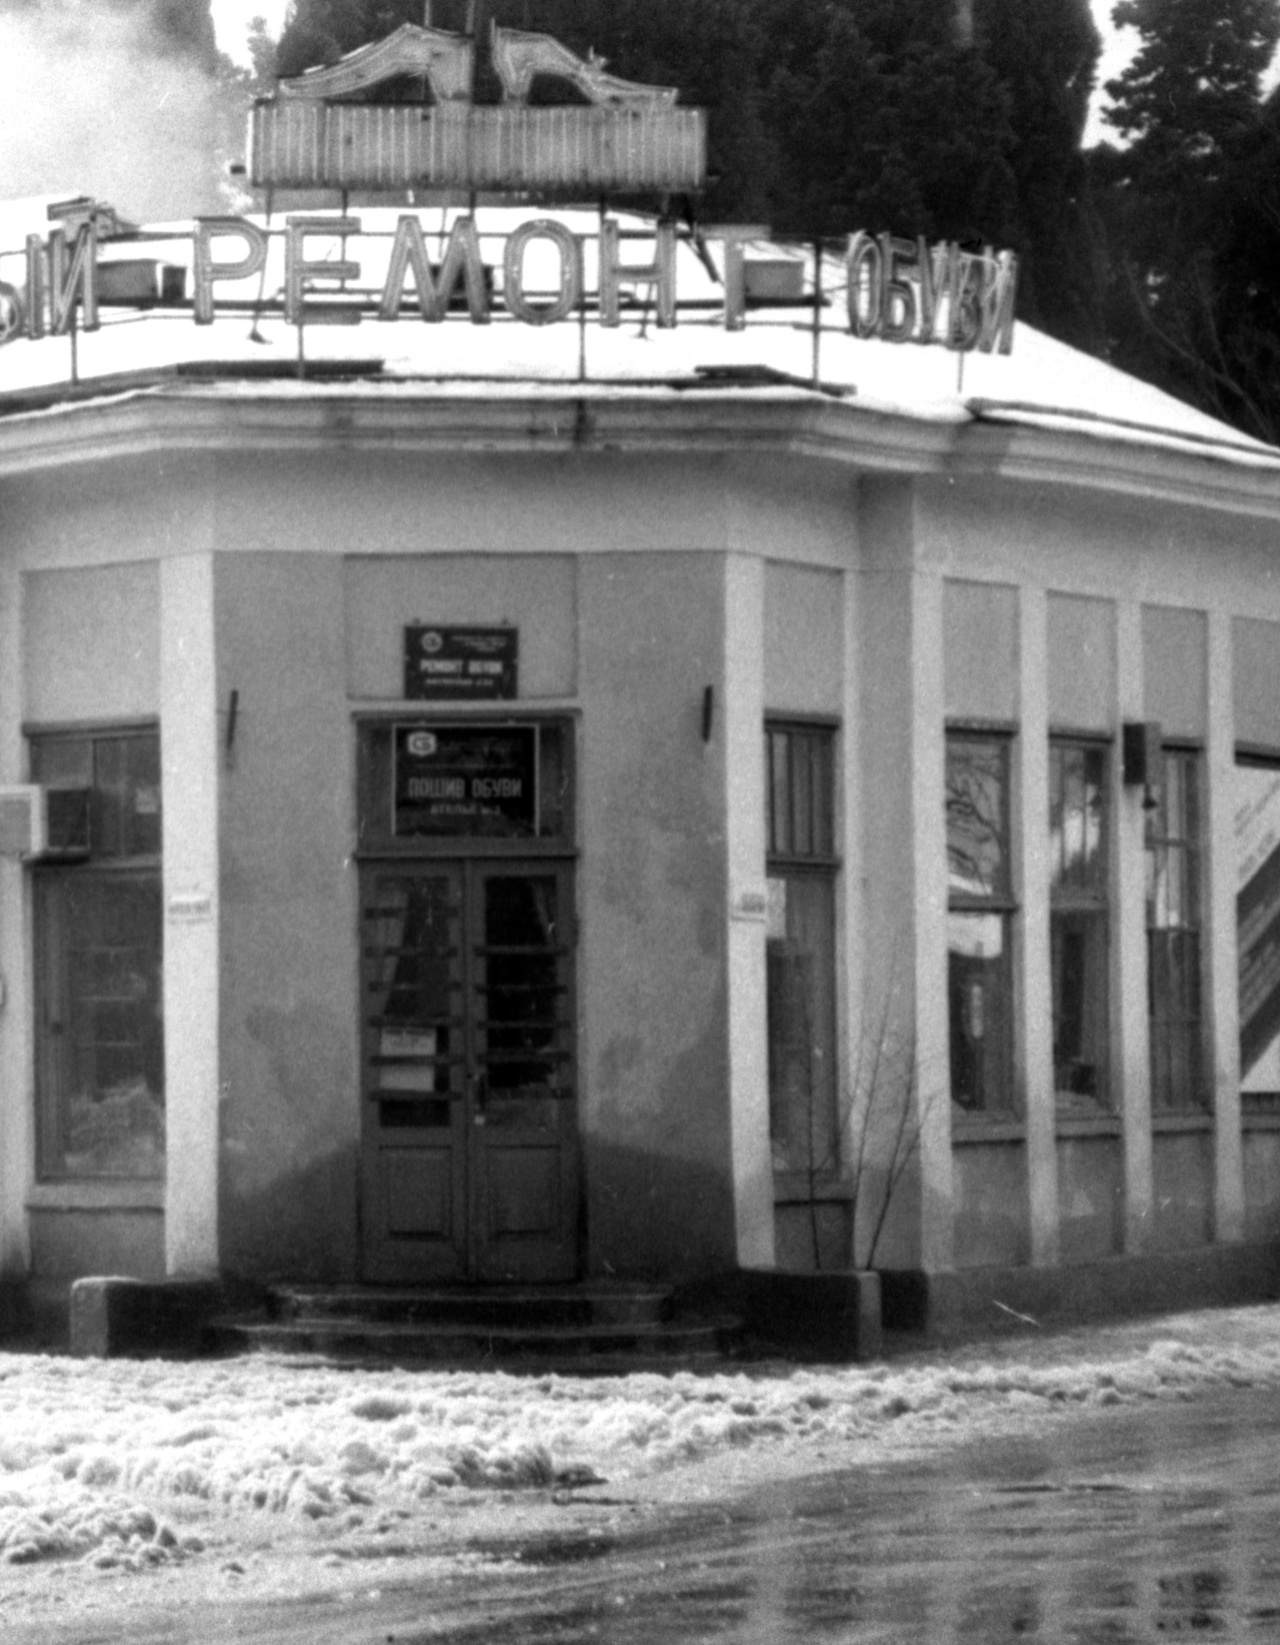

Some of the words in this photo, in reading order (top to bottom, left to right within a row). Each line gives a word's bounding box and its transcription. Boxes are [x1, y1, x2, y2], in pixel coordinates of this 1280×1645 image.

[194, 214, 772, 332] РЕМОНТ
[846, 229, 1017, 356] ОБУВИ
[409, 777, 465, 798] ПОШИВ
[472, 777, 522, 798] ОБУВИ
